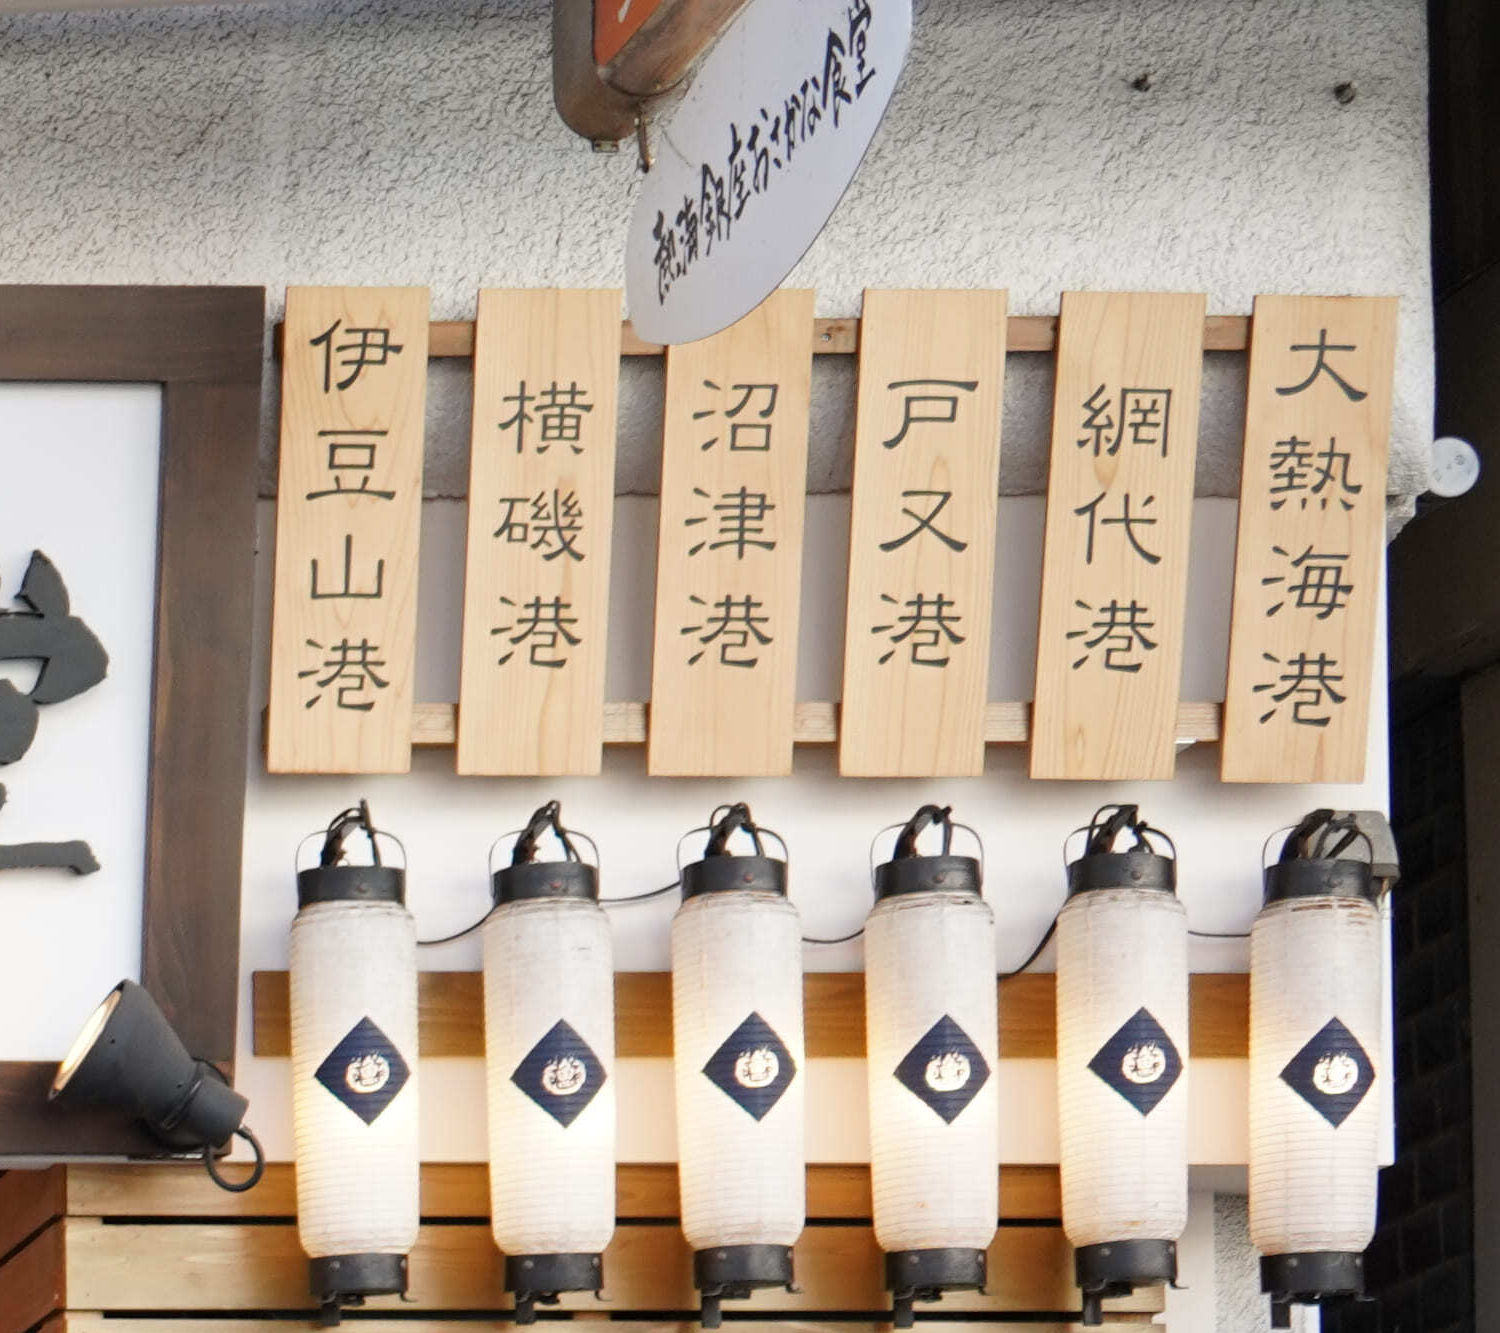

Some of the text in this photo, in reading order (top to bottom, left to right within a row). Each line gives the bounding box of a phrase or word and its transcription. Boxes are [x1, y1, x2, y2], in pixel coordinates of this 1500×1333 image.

[652, 0, 877, 306] 熱海銀座おさかな食堂
[297, 317, 404, 713] 伊豆山港
[490, 378, 595, 669] 横磯港
[680, 377, 780, 669] 沼津港
[871, 377, 979, 669] 戸又港
[1065, 383, 1172, 674] 網代港
[1254, 328, 1371, 727] 大熱海港
